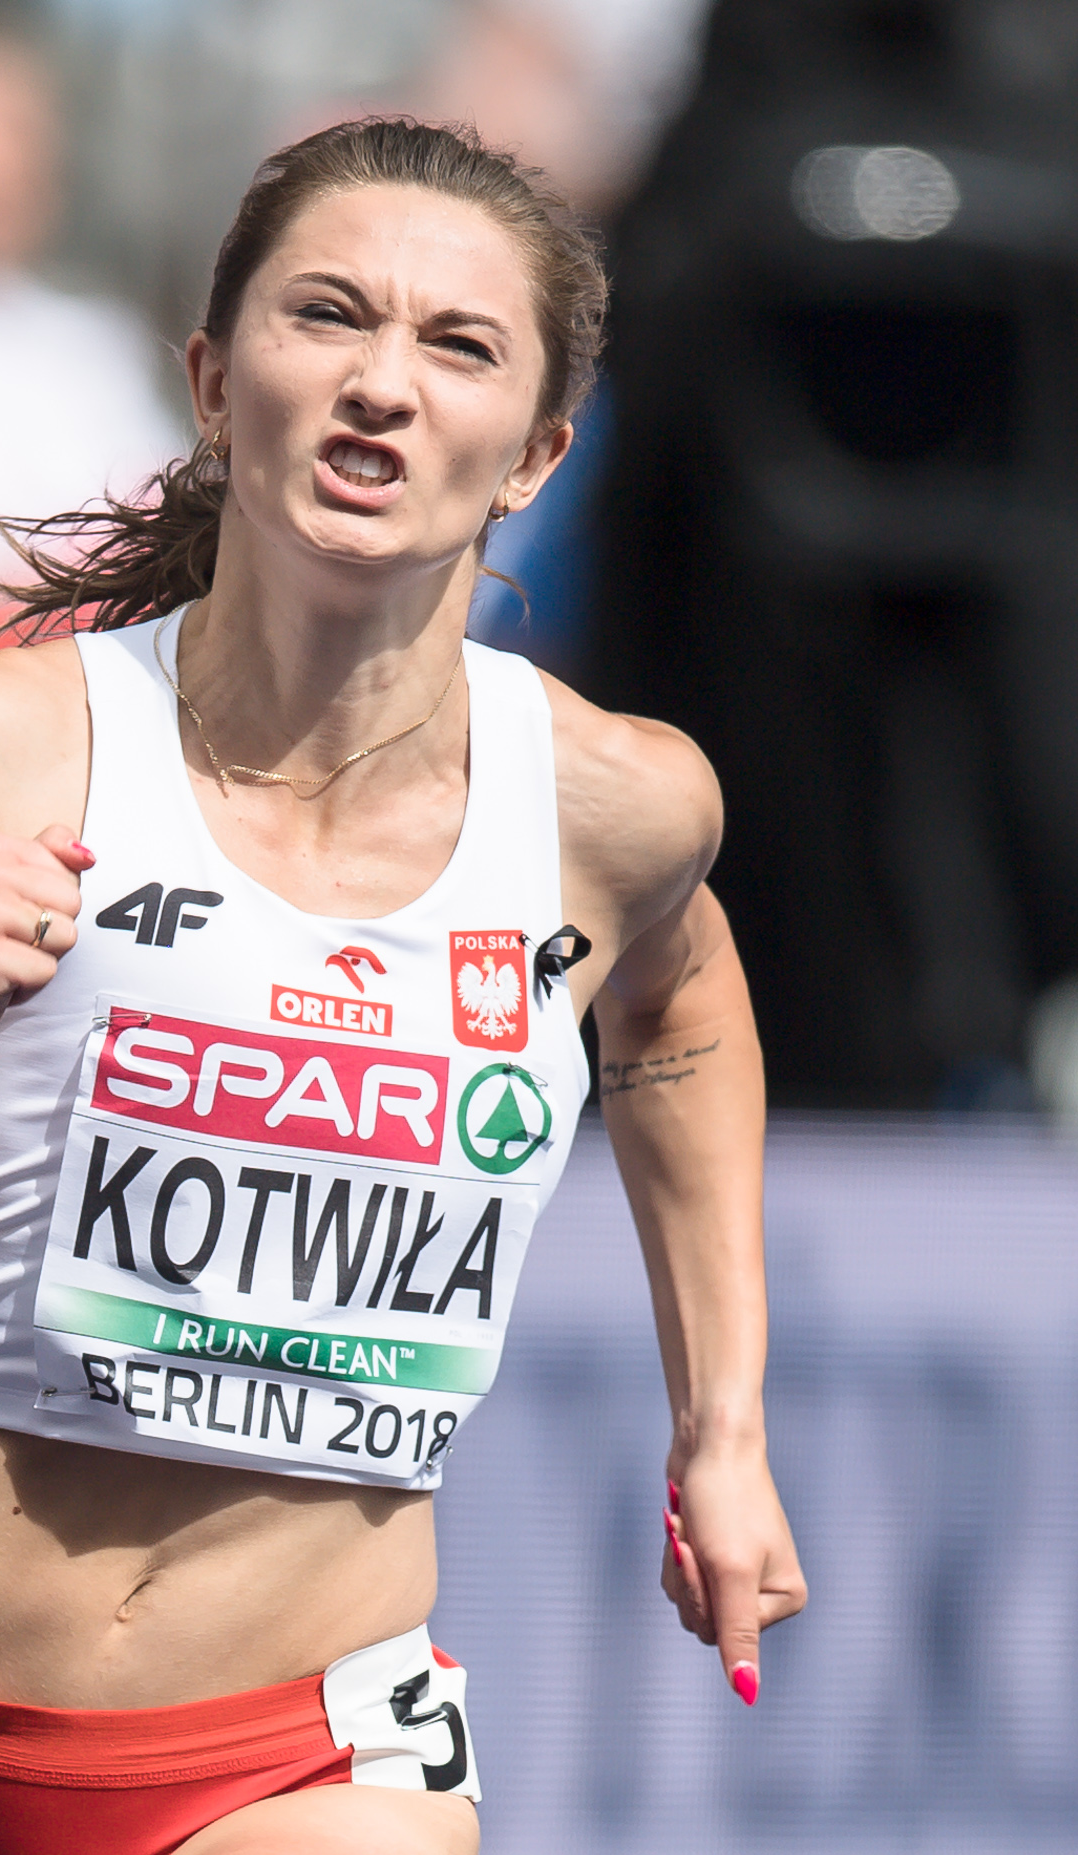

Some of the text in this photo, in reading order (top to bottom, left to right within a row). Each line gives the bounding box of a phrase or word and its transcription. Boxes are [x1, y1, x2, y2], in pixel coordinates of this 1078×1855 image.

[95, 881, 224, 948] 4F
[453, 934, 520, 952] POLSKA
[276, 991, 387, 1036] ORLEN
[107, 1026, 440, 1148] SPAR
[72, 1135, 503, 1320] KOTWIŁA
[153, 1313, 166, 1346] I
[177, 1317, 268, 1363] RUN
[81, 1353, 458, 1463] BERLIN 2018
[389, 1669, 468, 1792] 5
